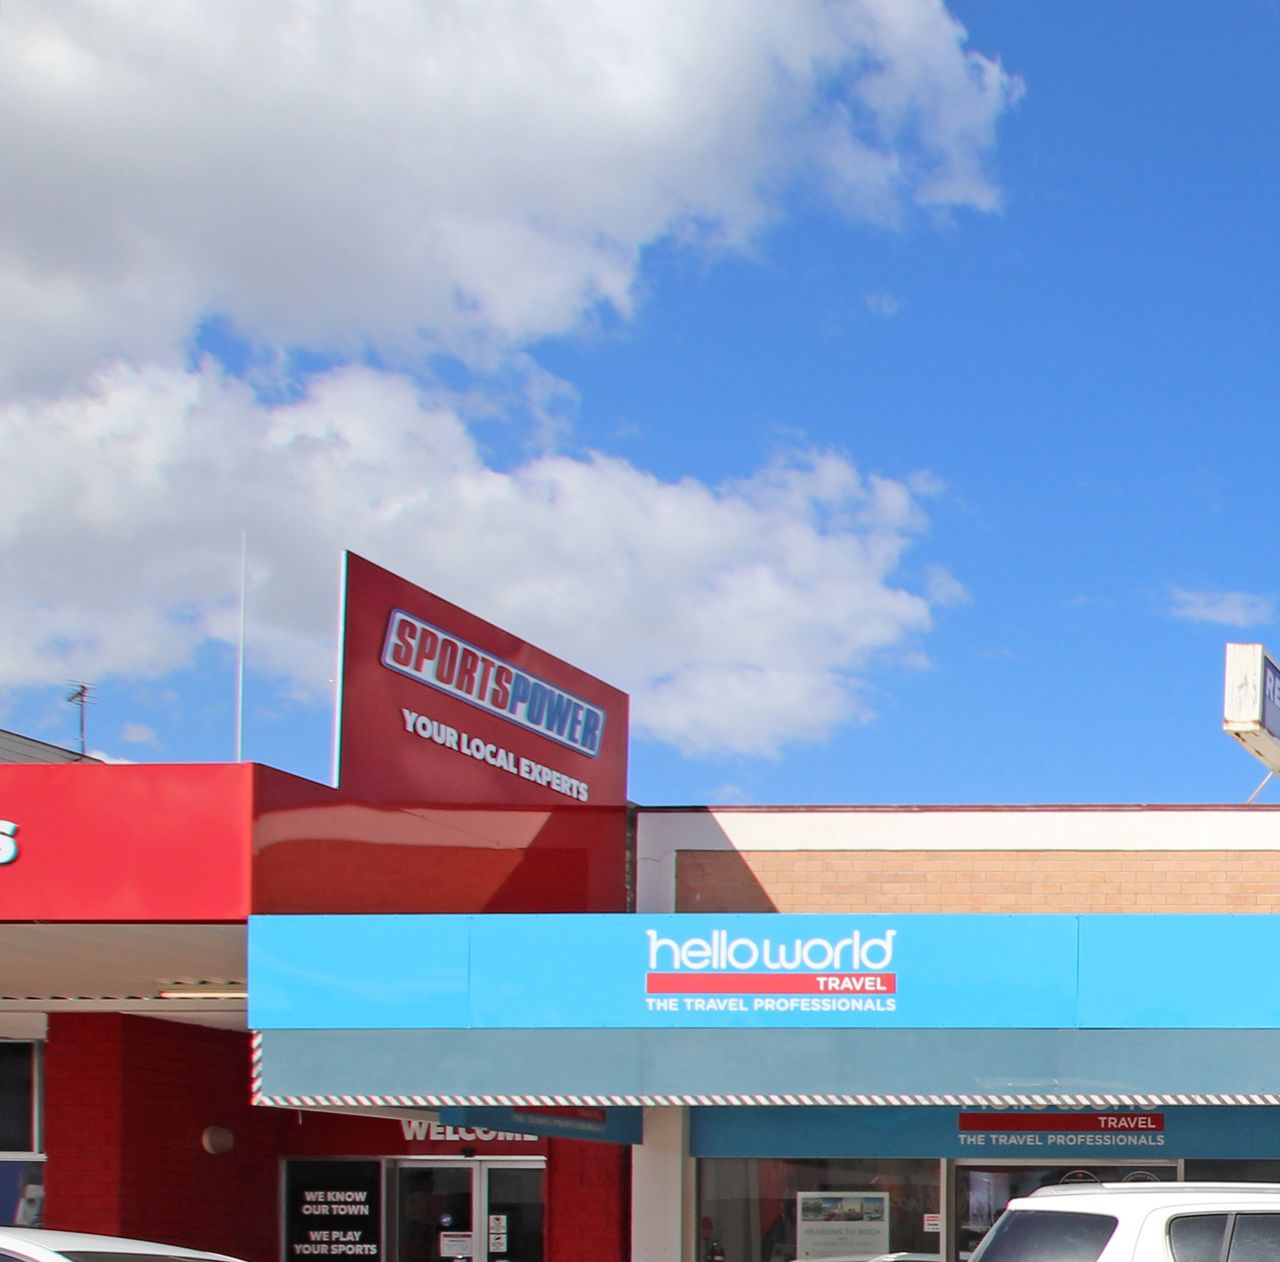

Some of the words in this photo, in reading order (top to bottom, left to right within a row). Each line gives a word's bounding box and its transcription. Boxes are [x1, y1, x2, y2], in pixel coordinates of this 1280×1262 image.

[391, 617, 601, 754] SPORTSPOWER
[402, 708, 459, 751] YOUR
[460, 733, 518, 775] LOCAL
[519, 756, 589, 802] EXPERTS
[816, 976, 887, 991] TRAVEL
[646, 998, 679, 1012] THE
[684, 998, 748, 1012] TRAVEL
[754, 998, 897, 1012] PROFESSIONALS
[1098, 1116, 1156, 1129] TRAVEL
[958, 1134, 985, 1146] THE
[990, 1134, 1043, 1146] TRAVEL
[1047, 1134, 1165, 1146] PROFESSIONALS
[304, 1191, 325, 1202] WE
[327, 1191, 367, 1202] KNOW
[302, 1204, 330, 1216] OUR
[331, 1204, 369, 1216] TOWN
[309, 1231, 330, 1241] WE
[331, 1231, 362, 1241] PLAY
[294, 1244, 329, 1255] YOUR
[331, 1244, 378, 1255] SPORTS
